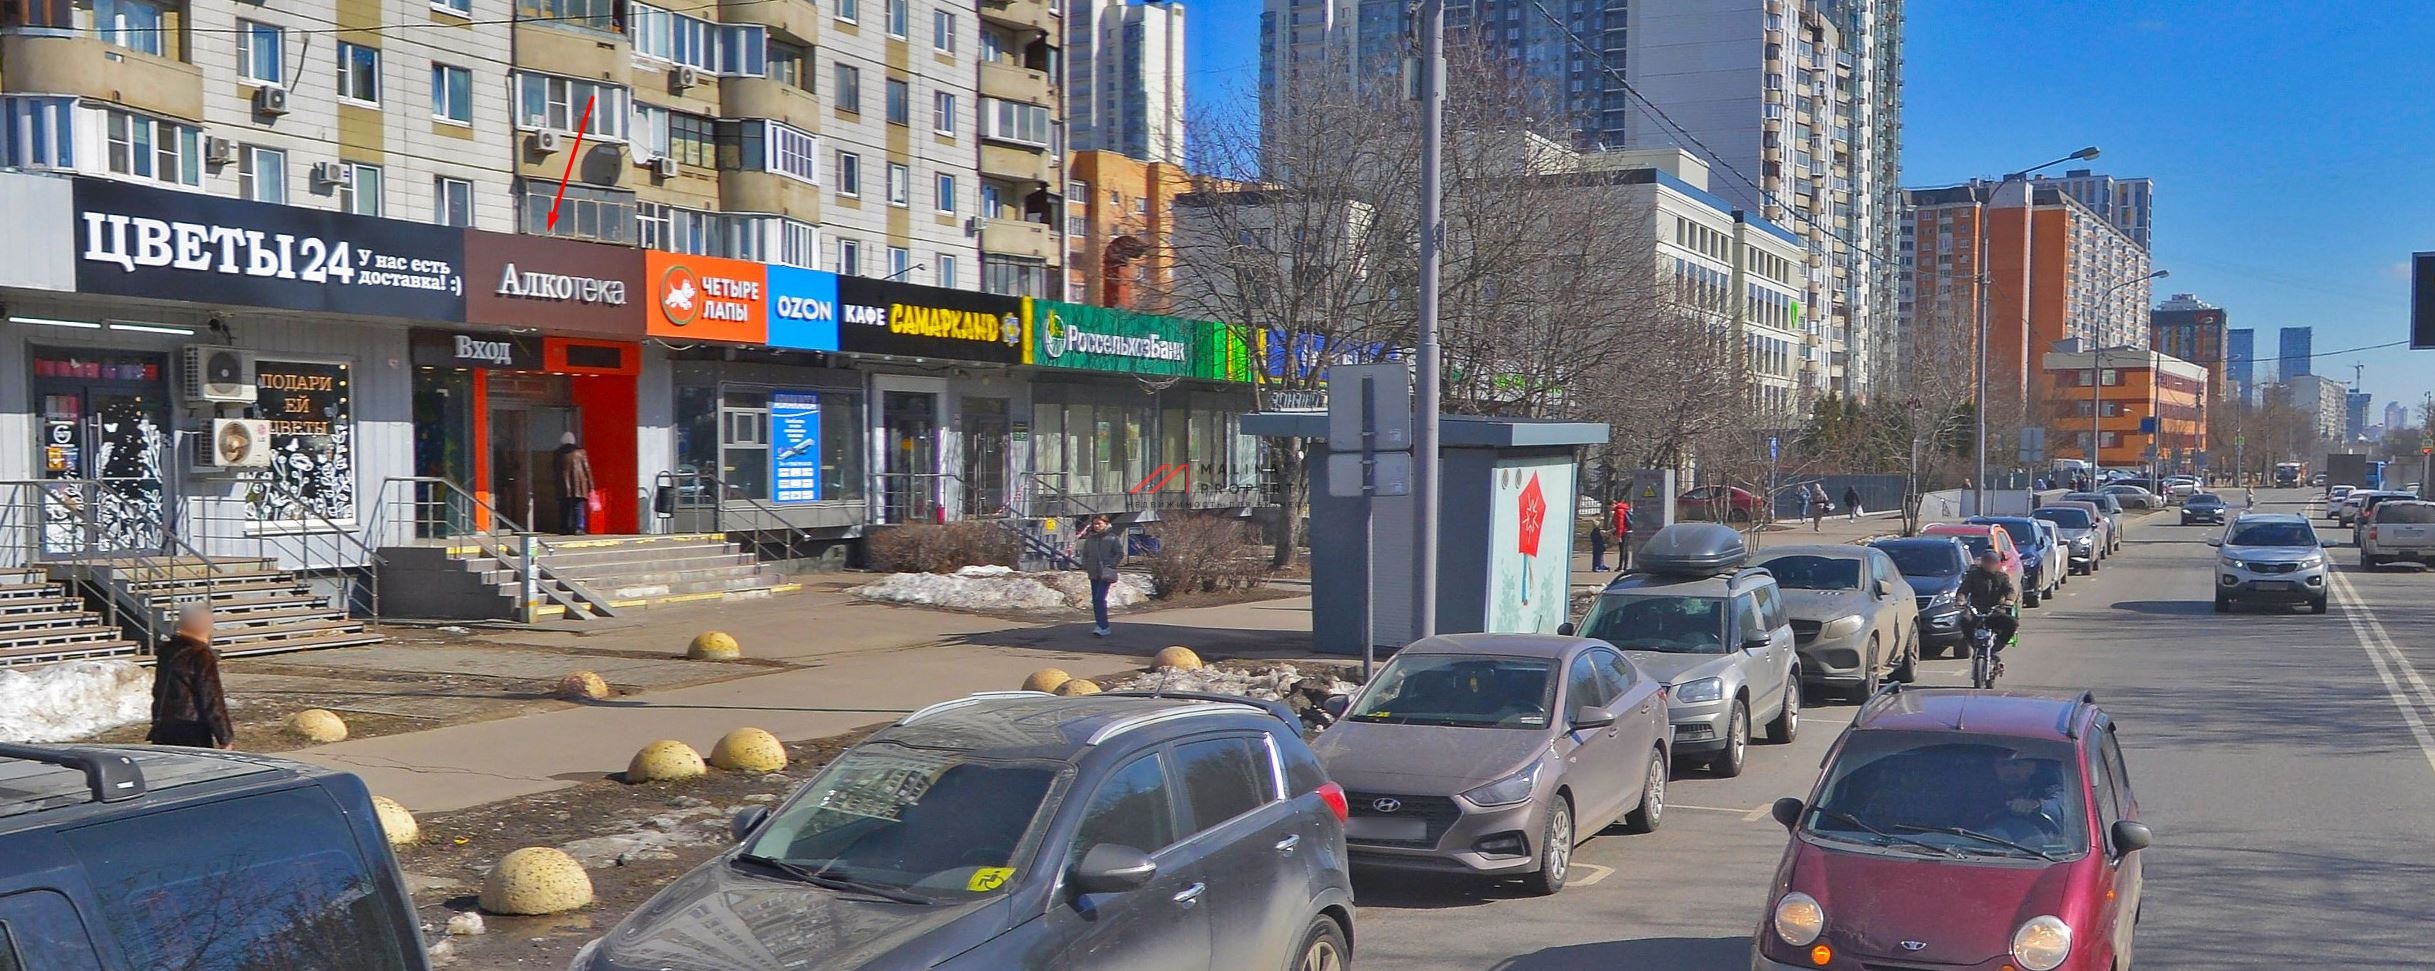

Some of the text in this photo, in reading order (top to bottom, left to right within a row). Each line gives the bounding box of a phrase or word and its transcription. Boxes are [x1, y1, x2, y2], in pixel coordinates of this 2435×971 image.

[83, 211, 355, 284] ЦВЕТЫ 24
[357, 248, 451, 275] У нас есть
[358, 270, 447, 291] доставка!
[496, 263, 627, 307] Алкотека
[702, 275, 759, 301] ЧЕТЫРЕ
[703, 300, 748, 322] ЛАПЫ
[777, 295, 832, 321] OZON
[844, 303, 998, 342] КАФЕ САМАРКАНД
[453, 336, 512, 365] Вход
[1067, 325, 1186, 361] РоссельхозБанк
[261, 374, 332, 391] ПОДАРИ
[285, 395, 310, 413] ЕЙ
[269, 421, 329, 435] ЦВЕТЫ
